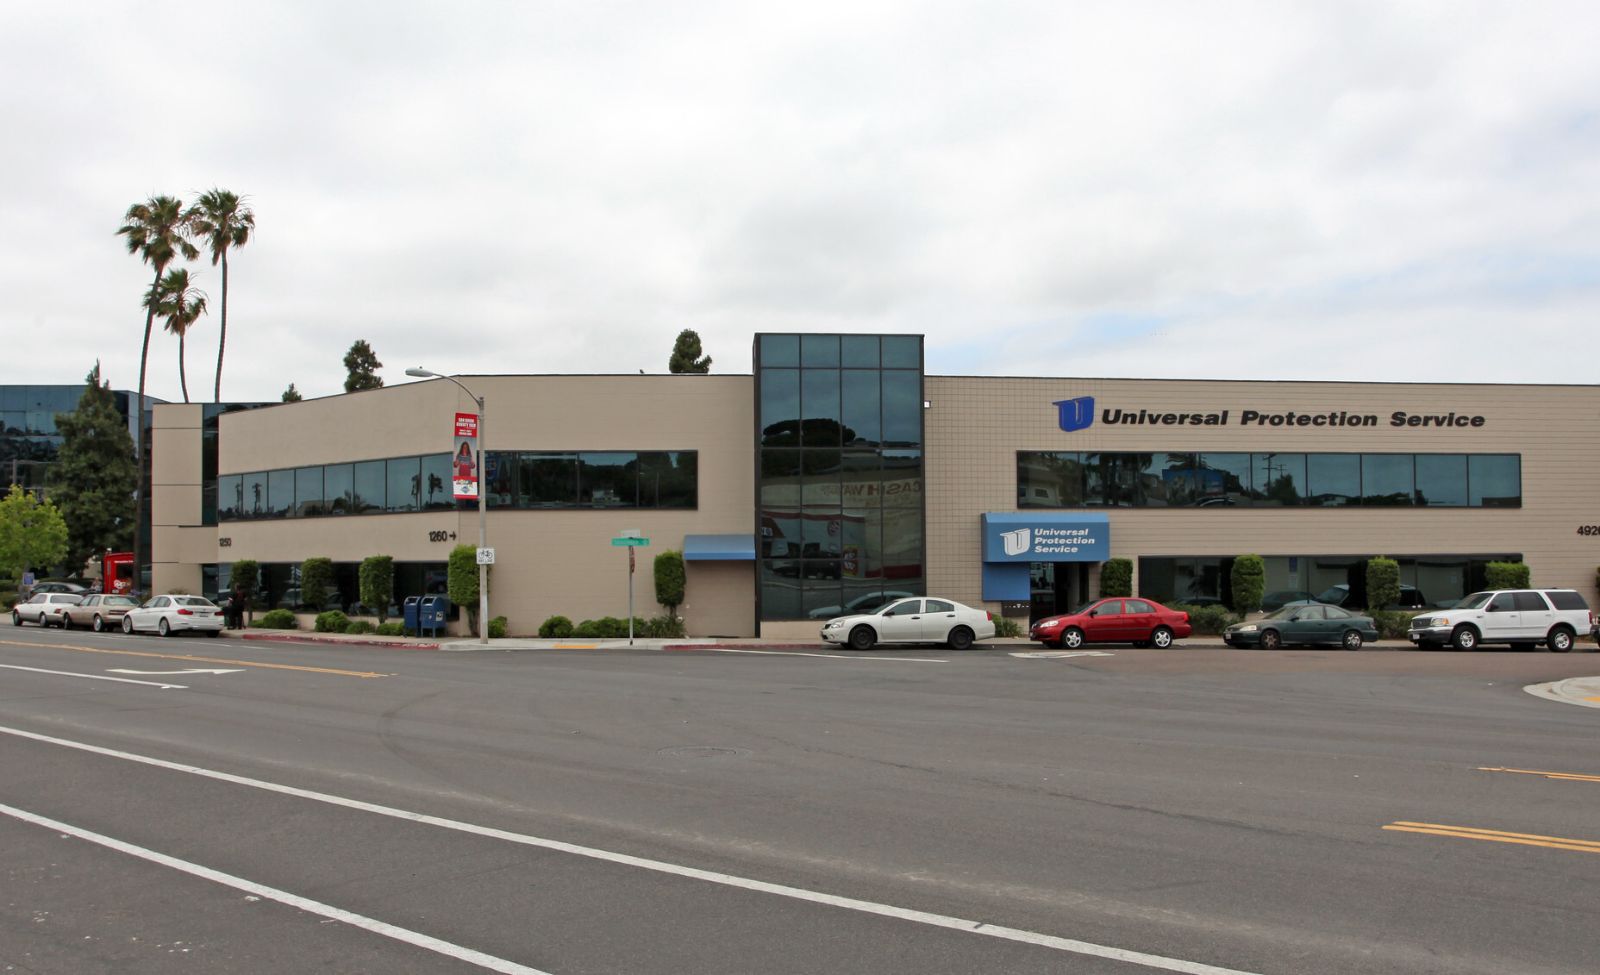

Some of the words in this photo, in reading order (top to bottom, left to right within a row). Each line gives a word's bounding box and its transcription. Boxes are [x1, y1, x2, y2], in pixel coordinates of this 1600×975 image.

[1102, 409, 1229, 426] Universal
[1240, 410, 1378, 427] Protection
[1390, 411, 1486, 428] Service
[429, 530, 448, 542] 1260
[1034, 528, 1089, 536] Universal
[1034, 537, 1095, 545] Protection
[1034, 545, 1078, 553] Service
